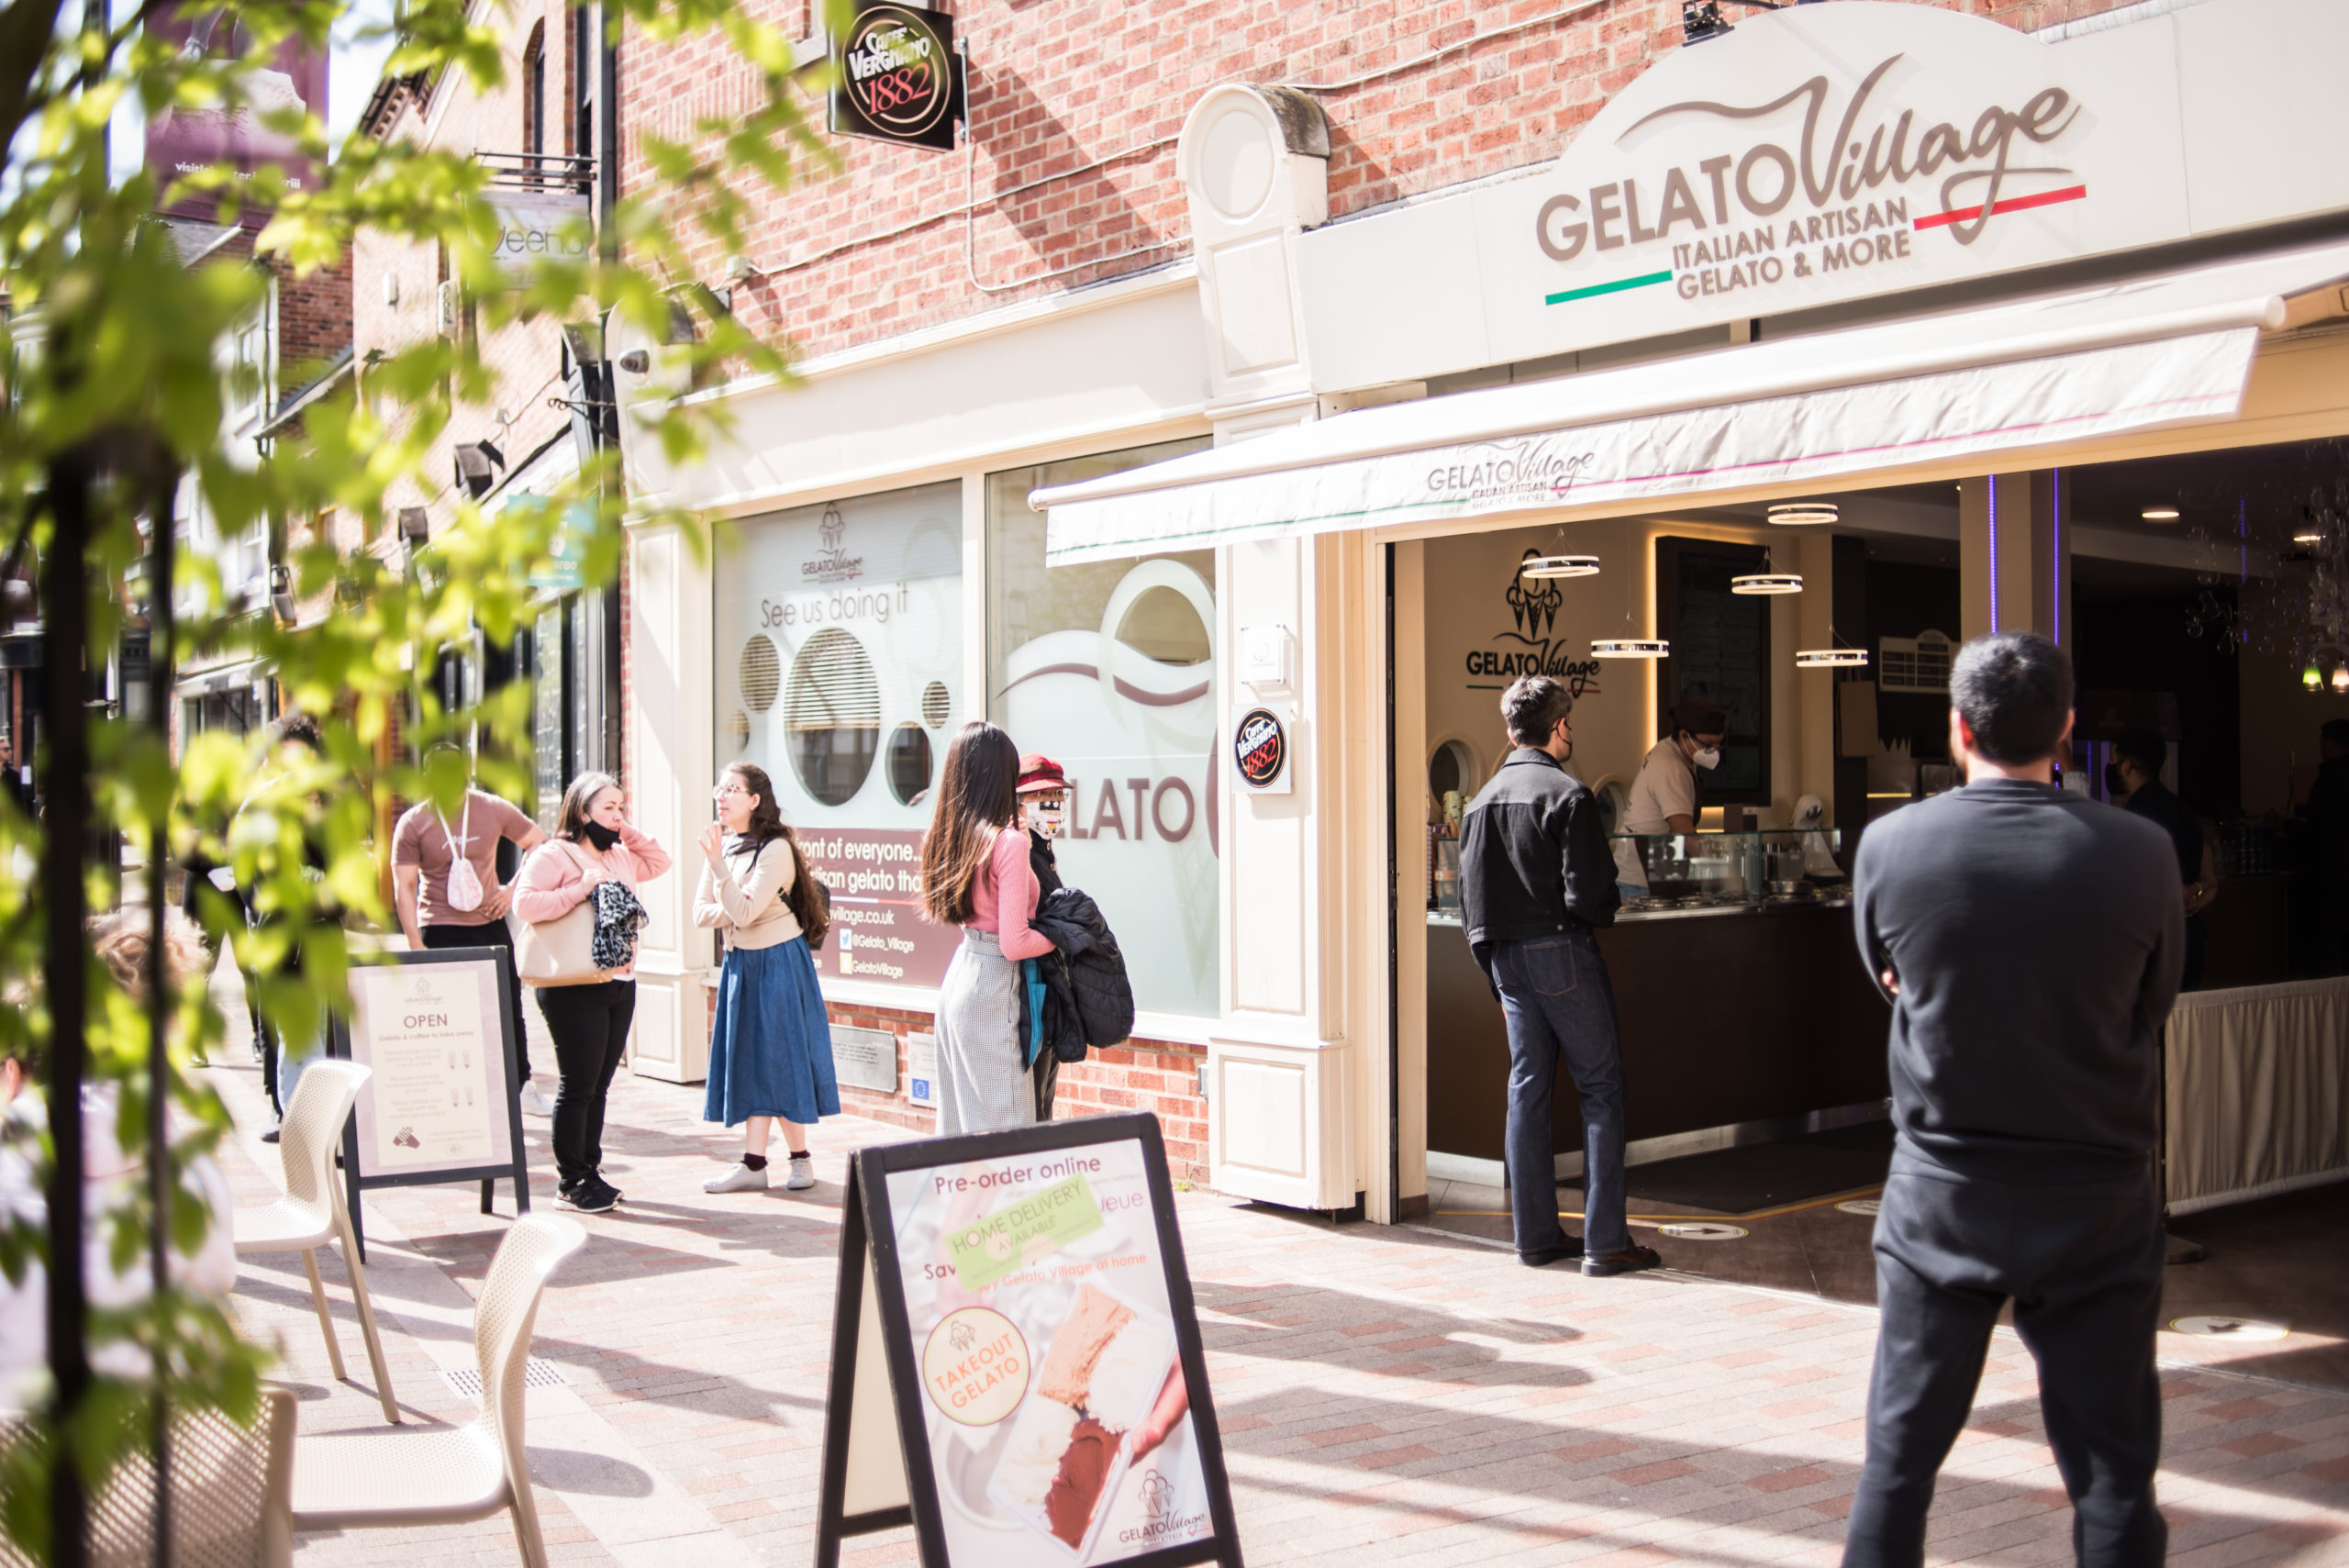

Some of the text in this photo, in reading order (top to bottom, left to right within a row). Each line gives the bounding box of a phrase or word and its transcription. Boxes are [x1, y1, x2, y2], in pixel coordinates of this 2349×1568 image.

[866, 61, 932, 115] 1882
[1536, 52, 2081, 262] GELATO Village
[1672, 196, 1909, 271] ITALIAN ARTISAN
[1676, 228, 1911, 301] GELATO & MORE
[1428, 438, 1595, 499] GELATO Village
[1508, 481, 1548, 494] ARTISAN
[802, 559, 833, 575] GELATO
[761, 581, 908, 628] See us doing it
[1466, 639, 1601, 699] GELATO Village
[1237, 721, 1277, 760] VERGNANO
[1246, 738, 1278, 778] 1882
[1055, 776, 1196, 843] LATO
[827, 837, 843, 860] of
[848, 869, 895, 895] gelato
[897, 869, 924, 893] tha
[829, 906, 896, 927] village.co.uk
[852, 934, 915, 954] @Gelato_Village
[852, 960, 904, 980] GelatoVillage
[404, 1013, 449, 1029] OPEN
[934, 1156, 1102, 1195] Pre-order online
[952, 1217, 1008, 1255] HOME
[1008, 1179, 1083, 1228] DELIVERY
[997, 1214, 1057, 1252] AVAILABLE
[923, 1262, 956, 1281] Sav
[1002, 1270, 1047, 1288] Gelato
[1050, 1262, 1094, 1279] Village
[1096, 1259, 1109, 1272] at
[1110, 1253, 1147, 1268] home
[934, 1333, 1014, 1394] TAKEOUT
[951, 1356, 1020, 1409] GELATO
[1119, 1507, 1206, 1543] GELATO Village
